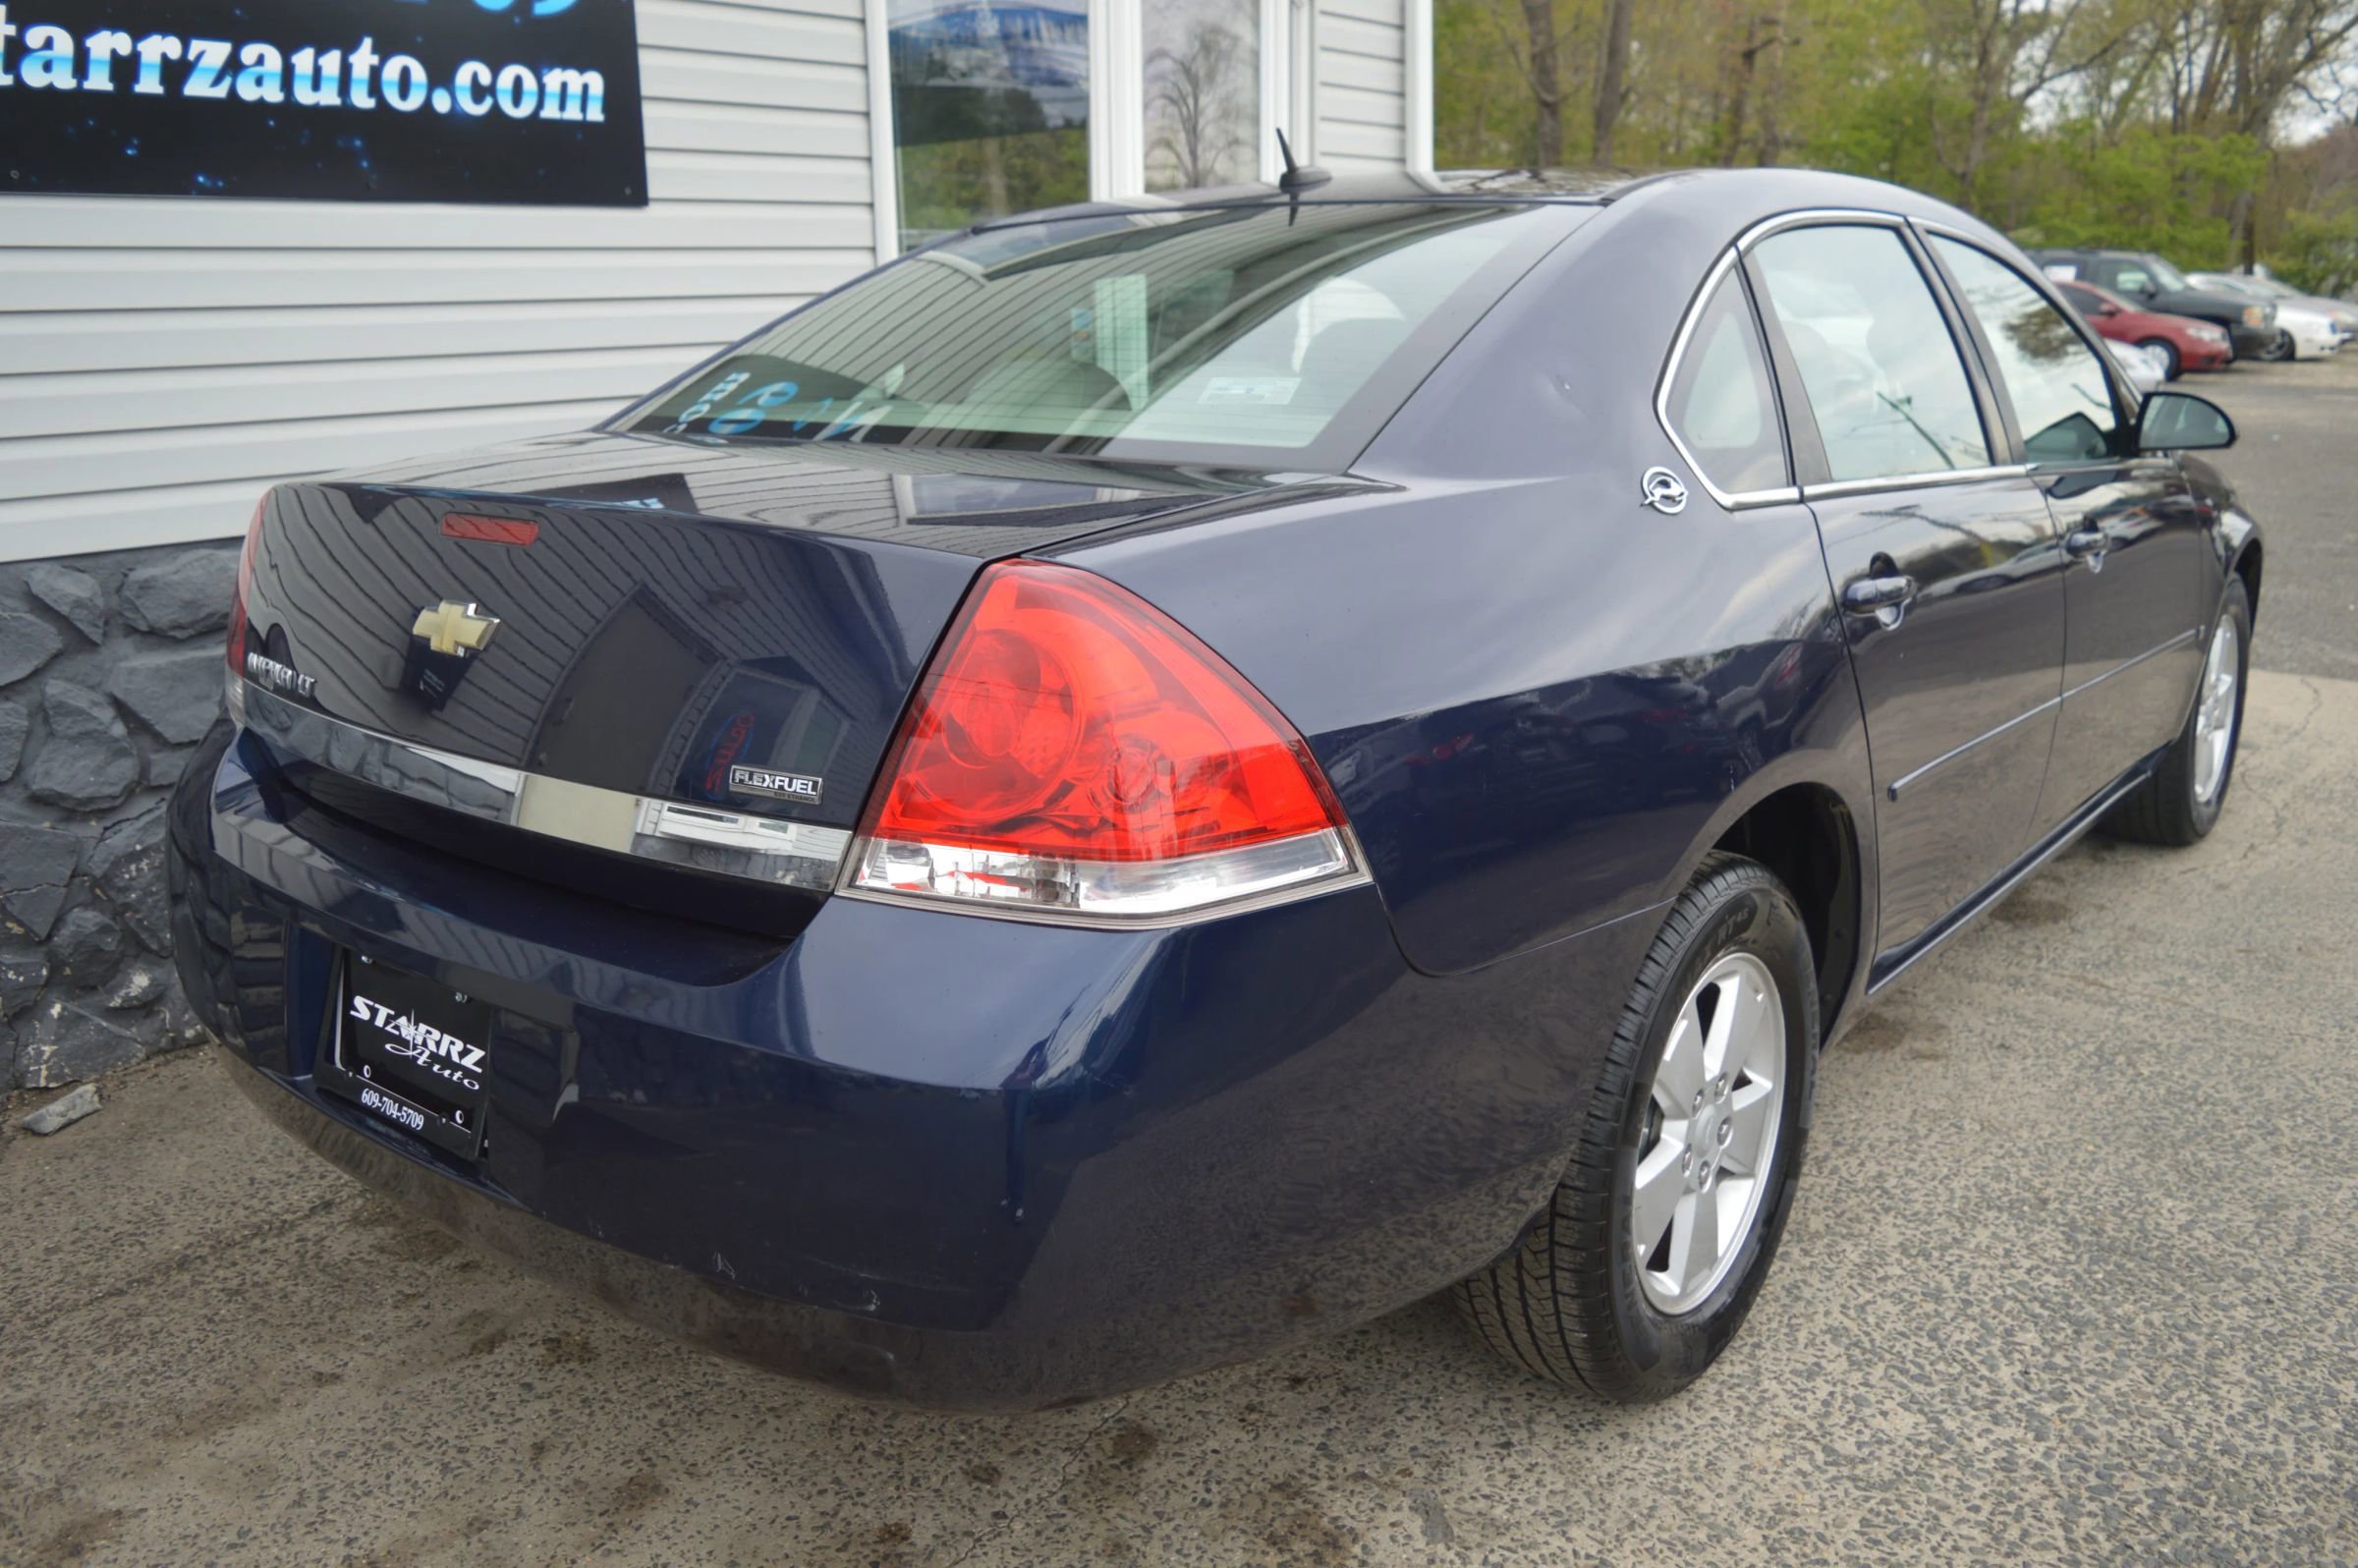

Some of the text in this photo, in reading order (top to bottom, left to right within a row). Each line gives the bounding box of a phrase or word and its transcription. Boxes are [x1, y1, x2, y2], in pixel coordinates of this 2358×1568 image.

[734, 770, 816, 795] FLEXFUEL
[350, 995, 486, 1073] STARRZ
[384, 1043, 479, 1091] Auto
[361, 1089, 424, 1131] 609-704-5709
